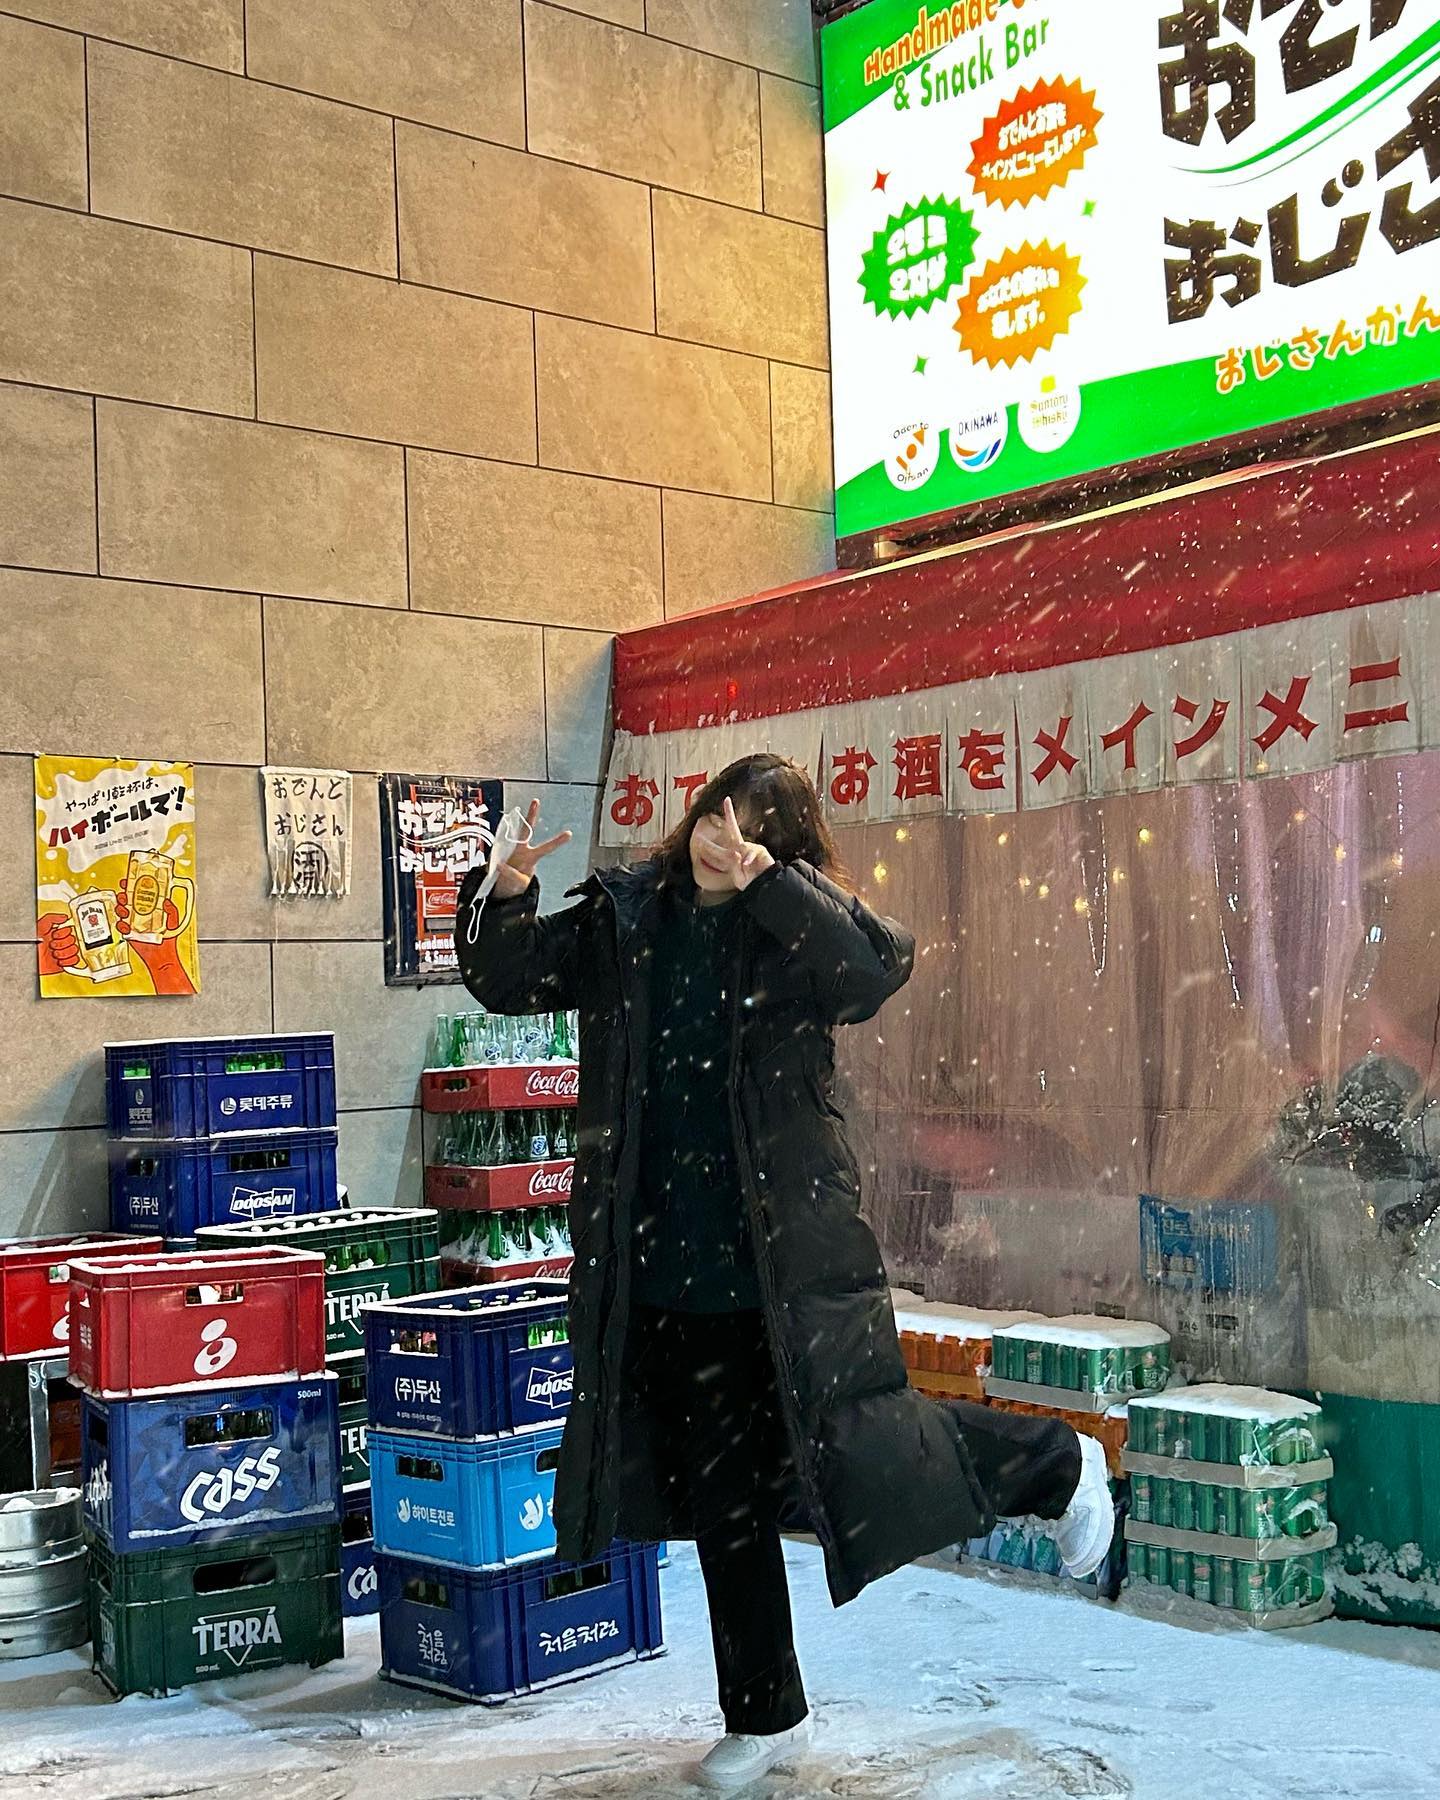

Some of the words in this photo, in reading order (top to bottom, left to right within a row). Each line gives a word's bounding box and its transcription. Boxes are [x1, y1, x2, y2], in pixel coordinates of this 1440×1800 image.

[864, 0, 998, 85] Handmade
[893, 73, 911, 111] &
[920, 35, 994, 107] Snack
[1005, 17, 1050, 70] Bar
[958, 411, 999, 436] OKINAWA
[65, 776, 159, 813] やっぱり乾杯は、
[272, 777, 344, 801] おでんと
[274, 812, 344, 838] おじさん
[398, 799, 491, 838] おでんと
[399, 838, 487, 873] おじさん
[239, 1094, 293, 1112] 롯데주류
[129, 1196, 159, 1216] (주)두산
[232, 1194, 293, 1212] DOOSAN
[297, 1388, 322, 1399] 500ml
[394, 1376, 442, 1404] (주)두산
[411, 1503, 456, 1528] 하이트진로
[191, 1613, 283, 1656] TERRA
[538, 1619, 619, 1656] 처음처럼
